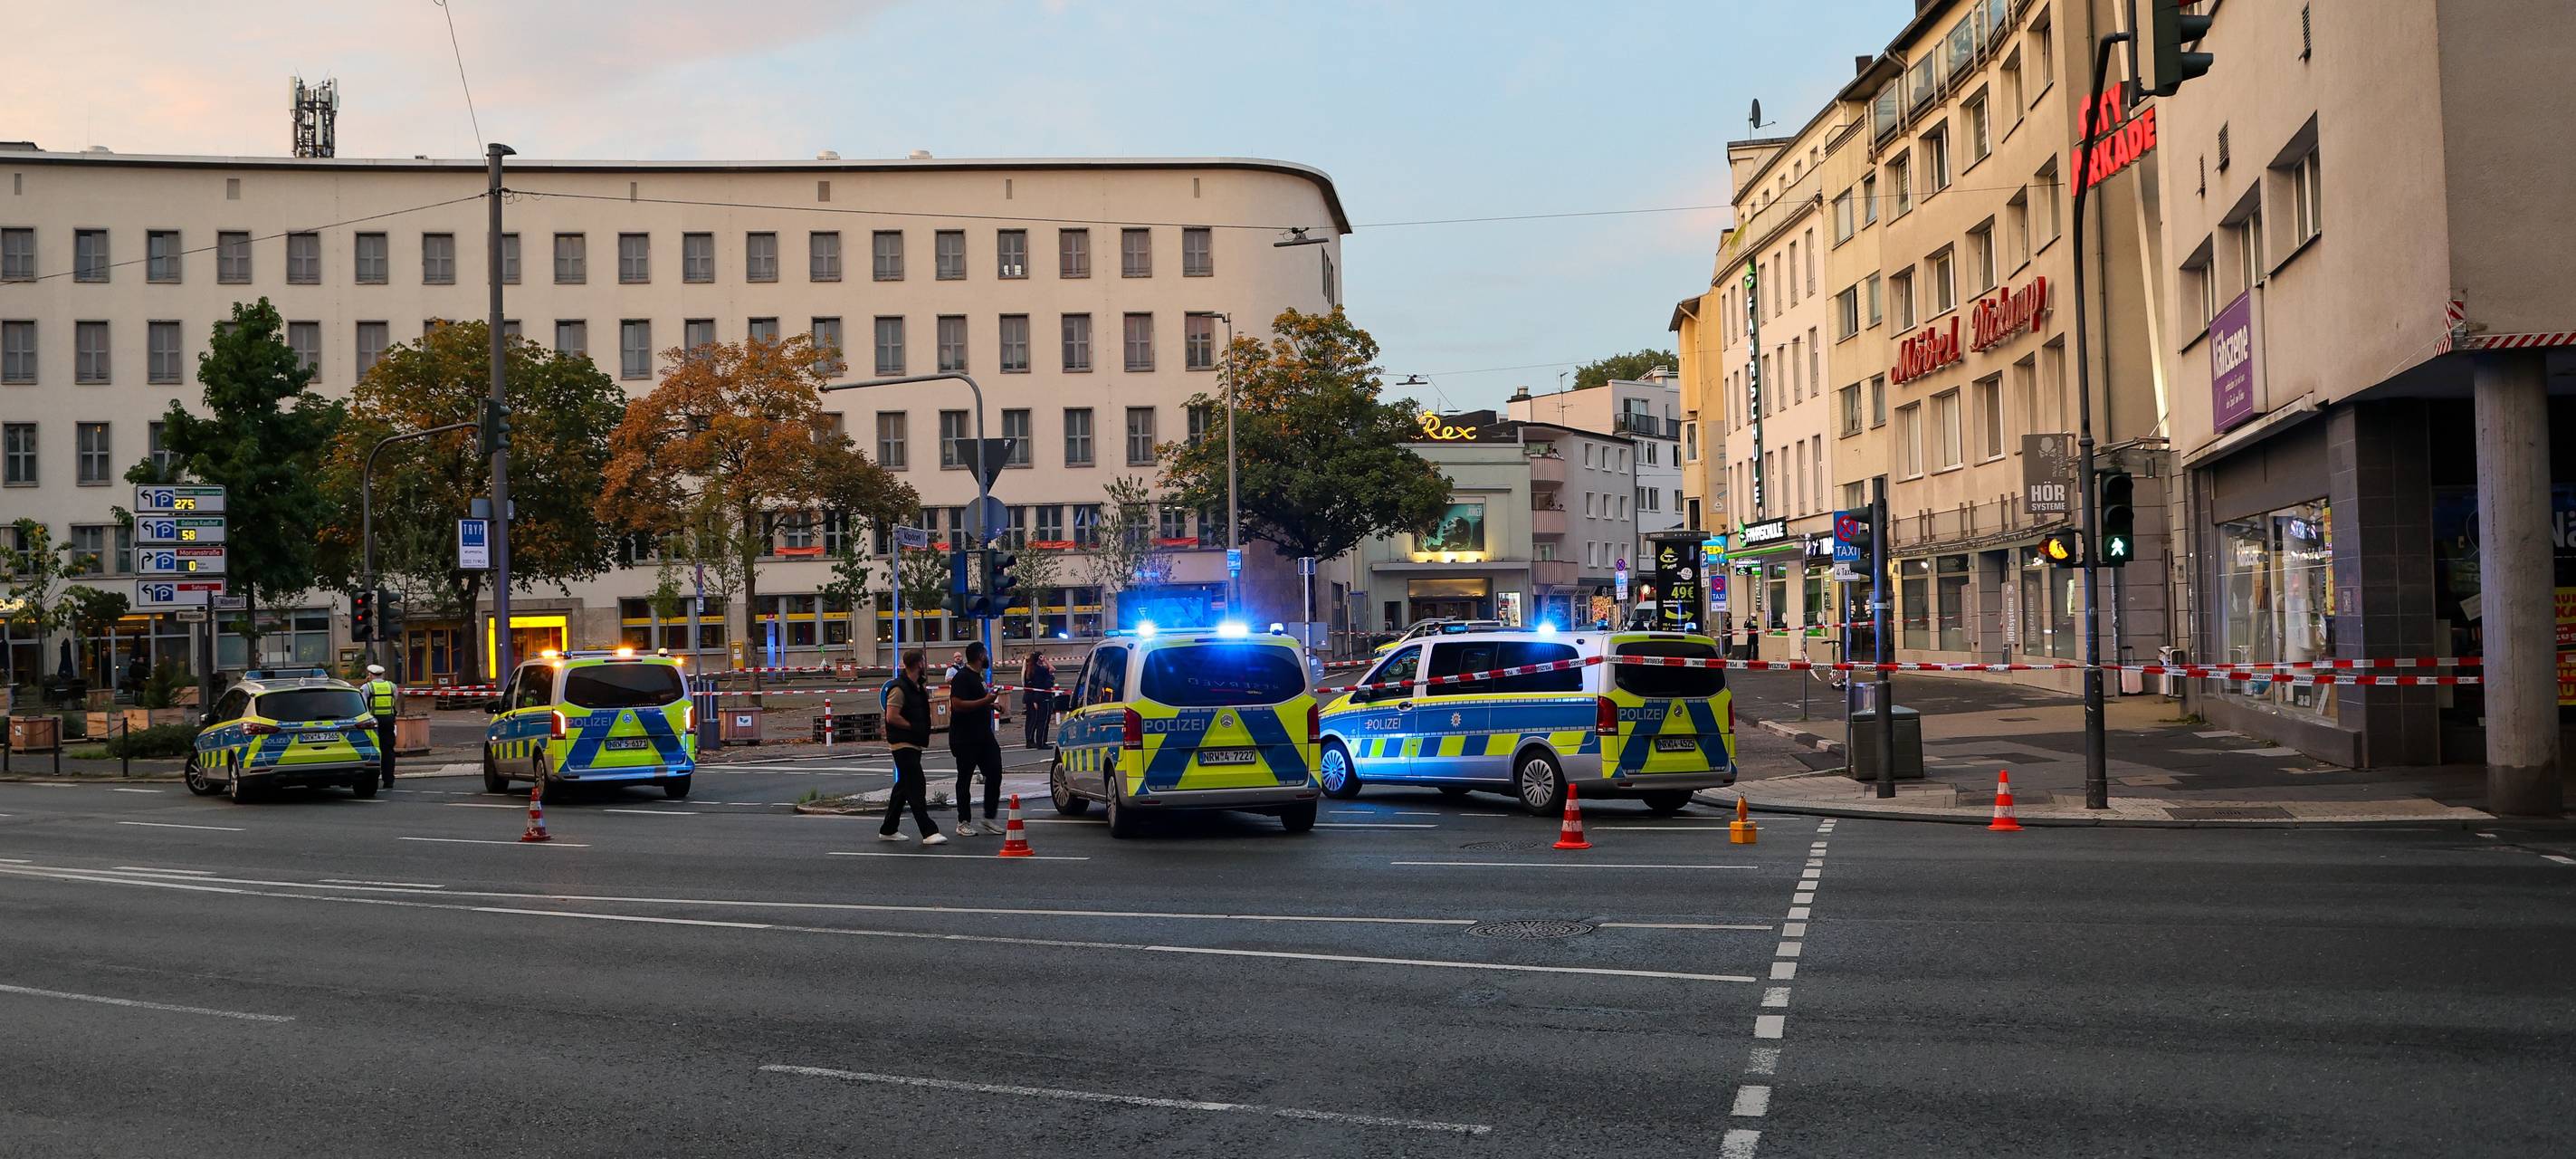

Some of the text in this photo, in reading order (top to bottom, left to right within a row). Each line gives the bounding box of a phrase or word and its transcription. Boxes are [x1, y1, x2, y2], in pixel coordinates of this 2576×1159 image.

[2078, 81, 2122, 141] CTY
[1891, 316, 1961, 385] Möbel
[2212, 325, 2248, 380] Nähszene
[1747, 296, 1761, 504] FAHRSCHULE
[1417, 414, 1477, 440] Rex
[2030, 481, 2066, 502] HÖR
[175, 499, 196, 510] 275
[2031, 503, 2066, 511] SYSTEME
[182, 530, 196, 541] 58
[463, 524, 483, 535] TRYP
[1836, 545, 1857, 557] TAXI
[188, 560, 196, 571] 0
[1671, 586, 1694, 599] 49€
[1618, 707, 1665, 721] POLIZEI
[567, 716, 612, 727] POLIZEI
[1143, 718, 1206, 733] POLIZEI
[1366, 718, 1401, 731] POLIZEI
[262, 736, 290, 745] POLIZEI
